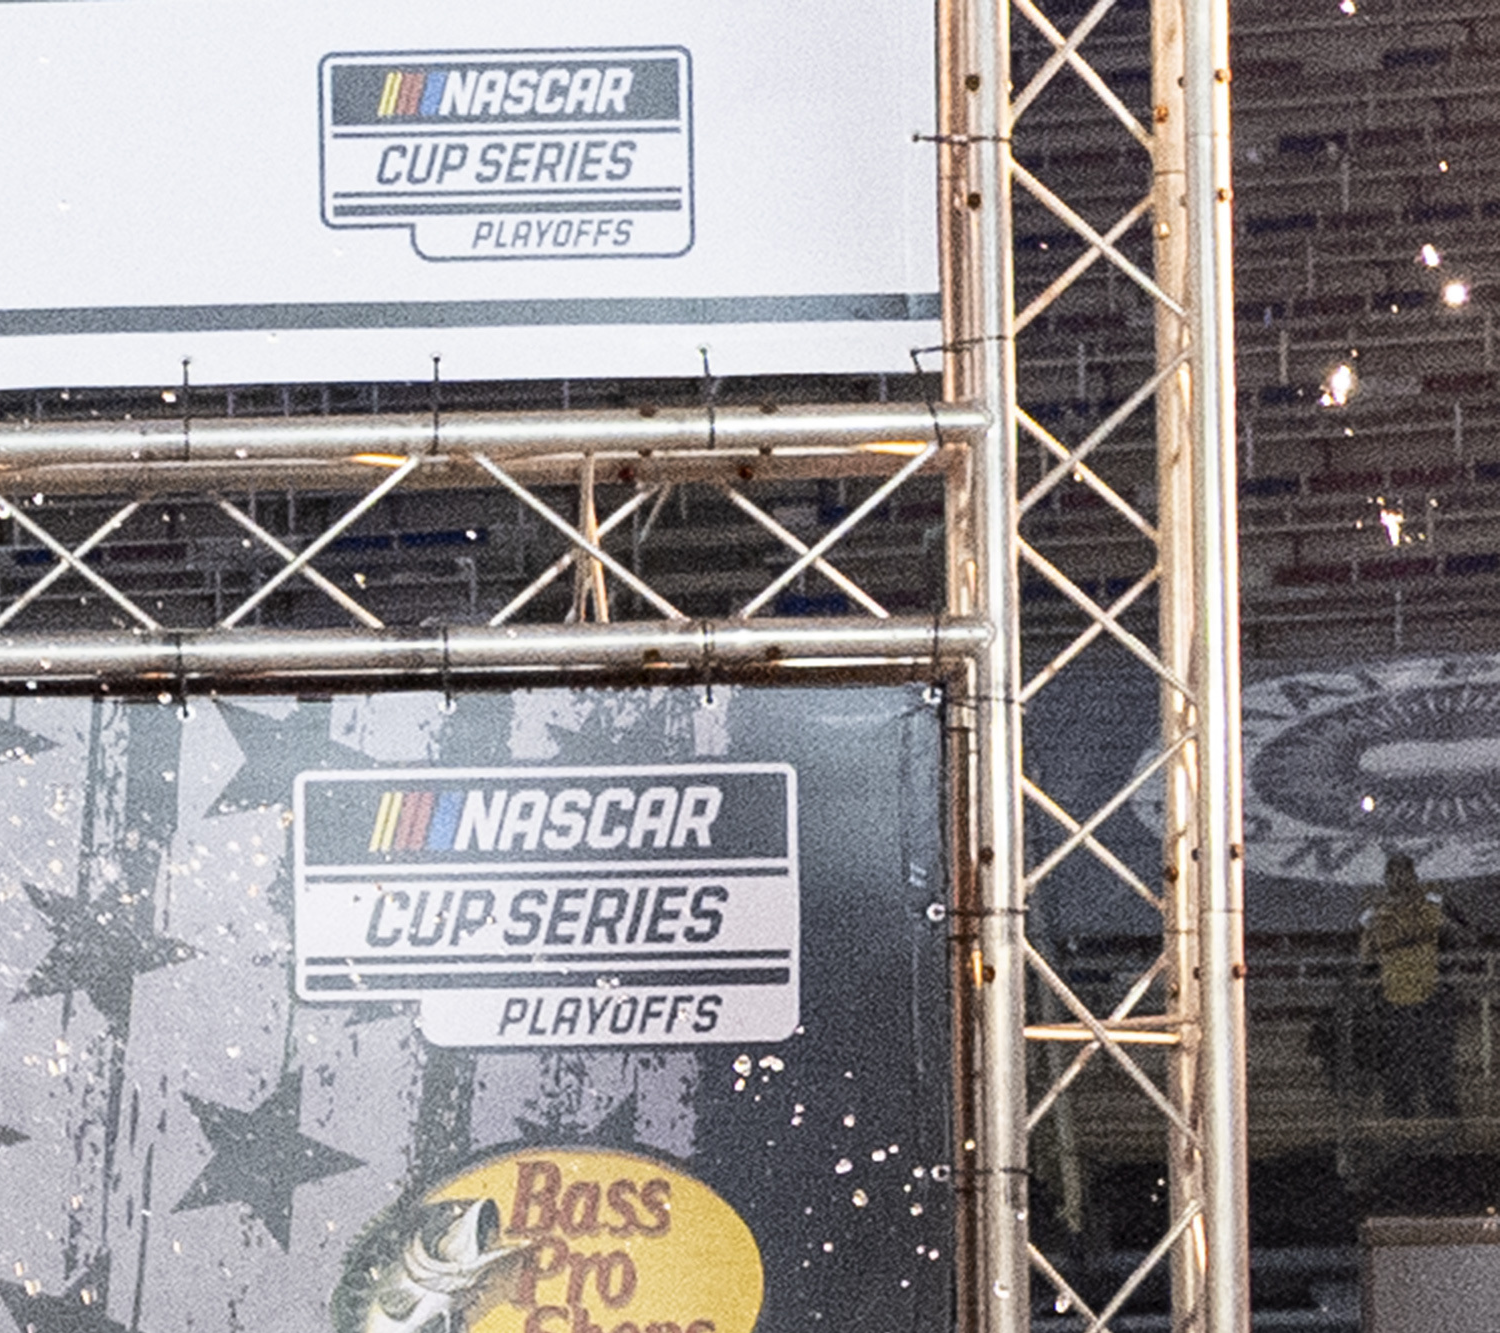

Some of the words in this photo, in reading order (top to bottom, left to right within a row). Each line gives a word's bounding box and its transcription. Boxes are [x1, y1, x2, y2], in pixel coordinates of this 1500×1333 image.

[436, 68, 633, 117] NASCAR
[375, 140, 465, 187] CUP
[475, 138, 636, 184] SERIES
[472, 218, 633, 250] PLAYOFFS
[454, 786, 723, 851] NASCAR
[365, 889, 497, 947] CUP
[502, 885, 729, 945] SERIES
[497, 994, 723, 1035] PLAYOFFS
[503, 1159, 672, 1237] Bass
[516, 1235, 638, 1310] Pro
